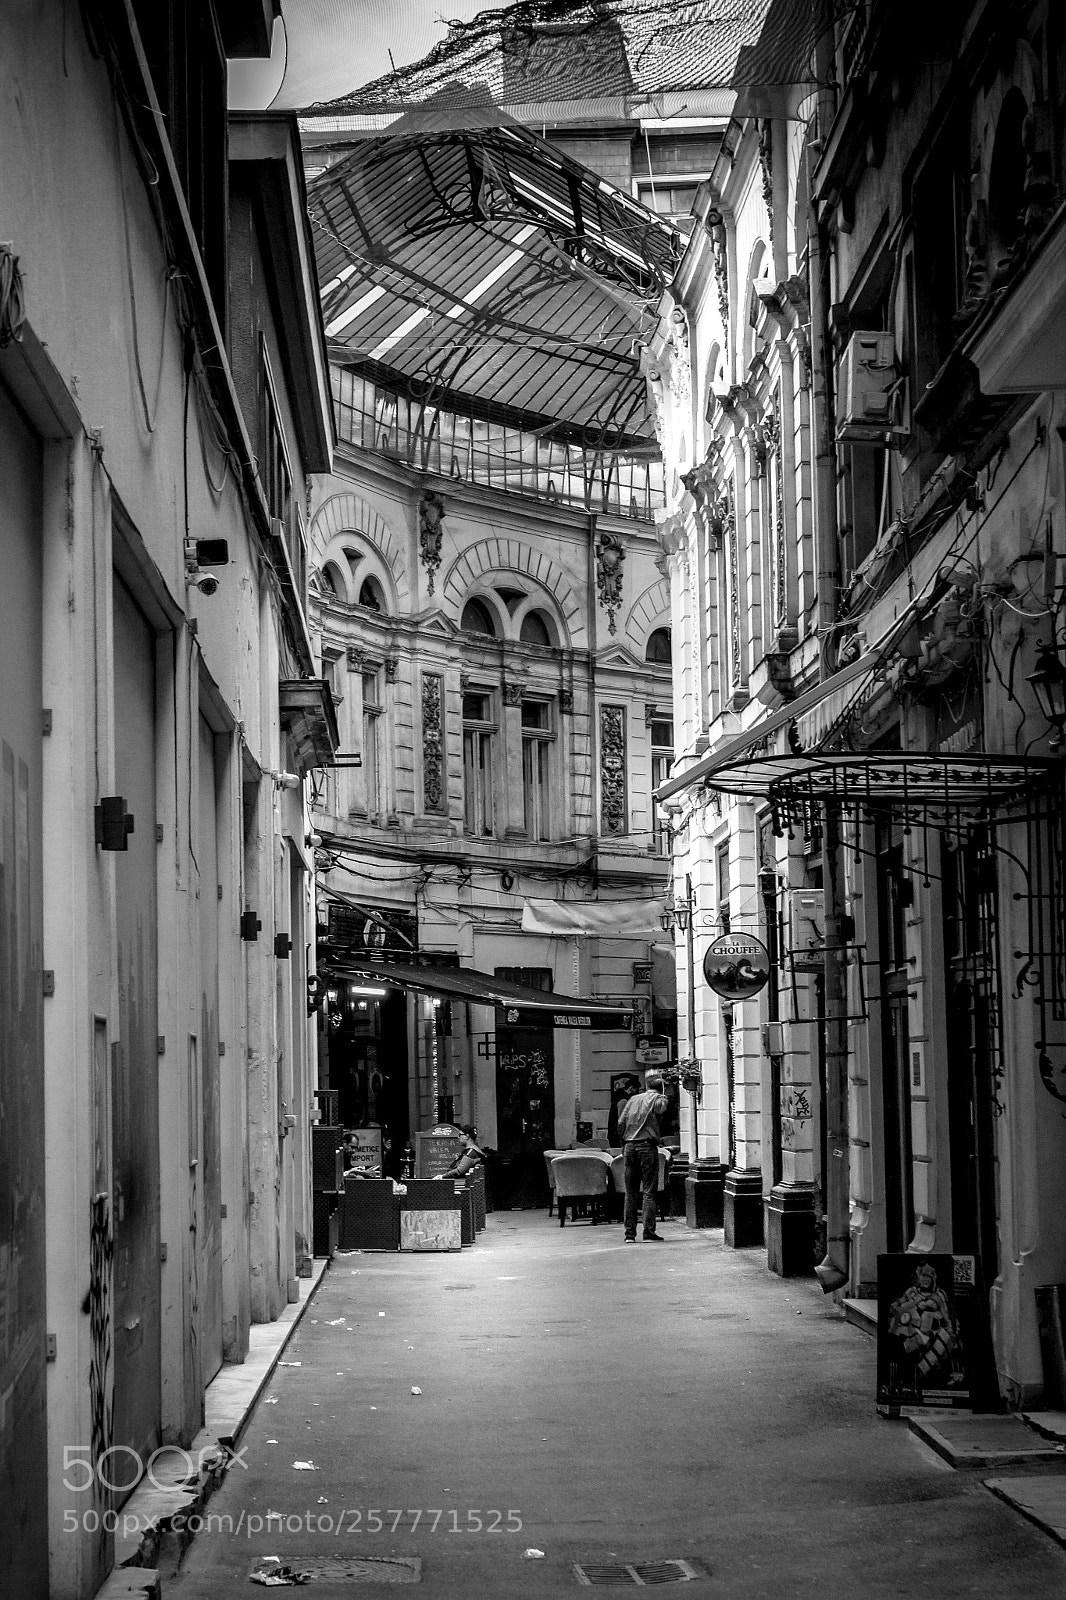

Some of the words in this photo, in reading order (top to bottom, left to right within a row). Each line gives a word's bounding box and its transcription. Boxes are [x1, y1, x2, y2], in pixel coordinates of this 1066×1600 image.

[712, 946, 760, 955] CHOUFFE
[356, 1145, 380, 1153] METICE
[351, 1154, 375, 1162] MPORT
